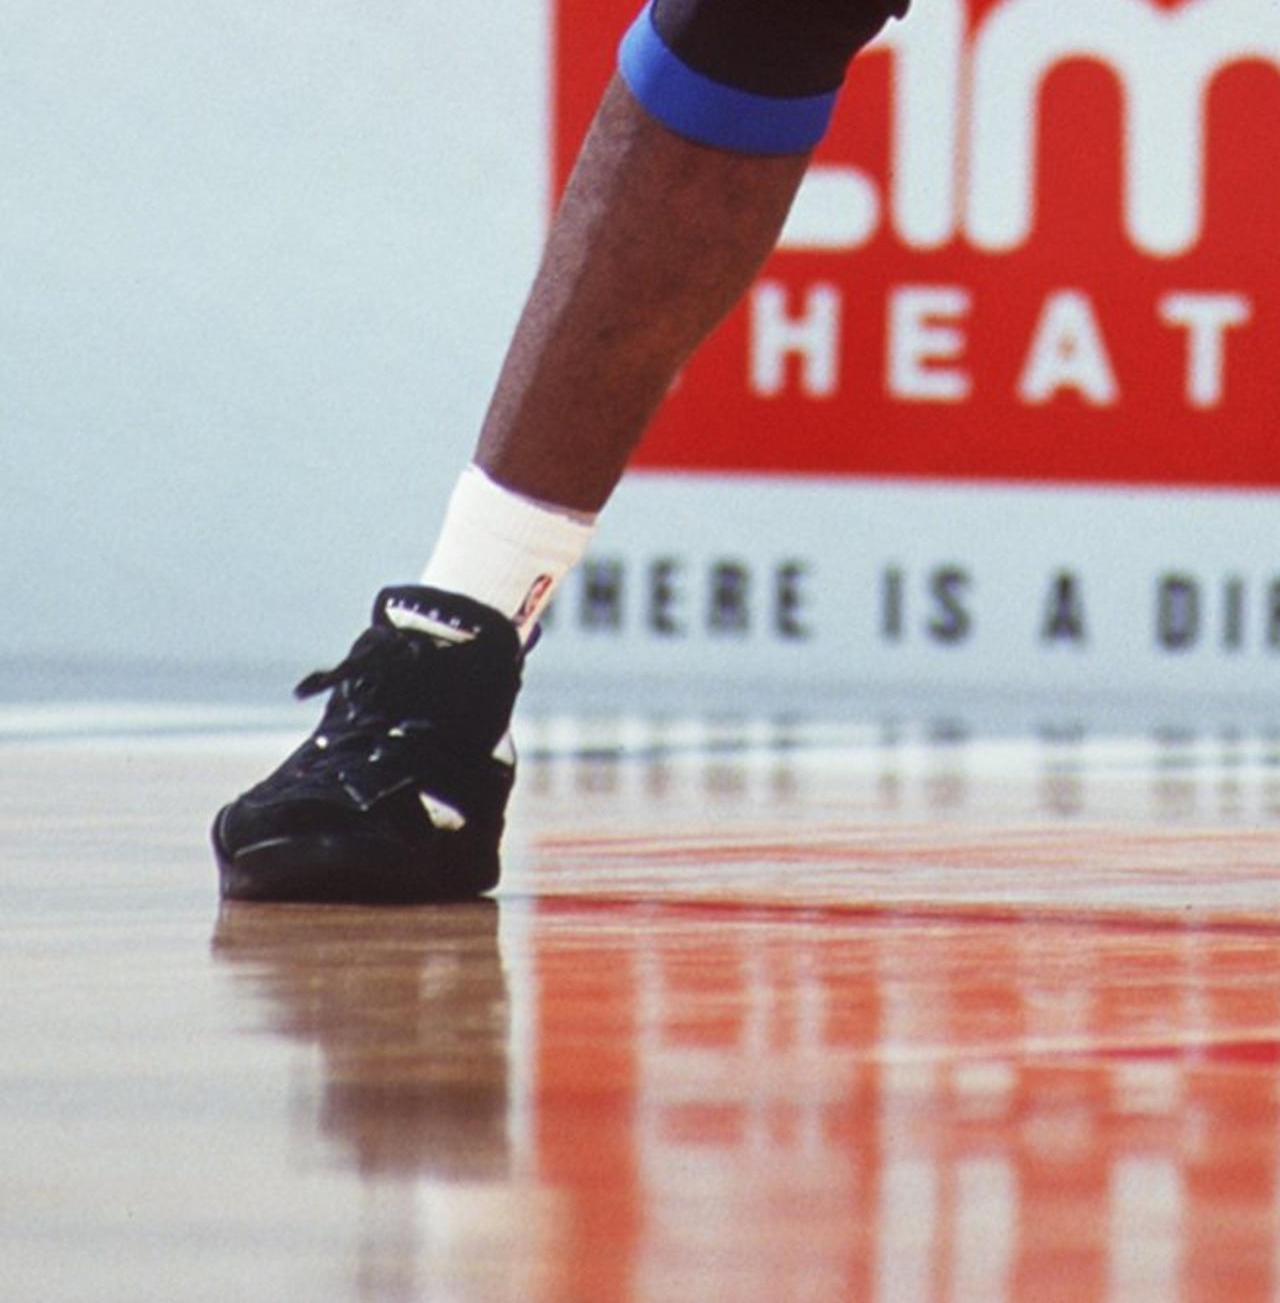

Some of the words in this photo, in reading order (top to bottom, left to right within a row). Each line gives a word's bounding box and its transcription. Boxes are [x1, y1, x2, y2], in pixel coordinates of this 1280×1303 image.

[543, 556, 808, 640] HERE
[883, 562, 969, 646] IS
[1042, 568, 1086, 648] A
